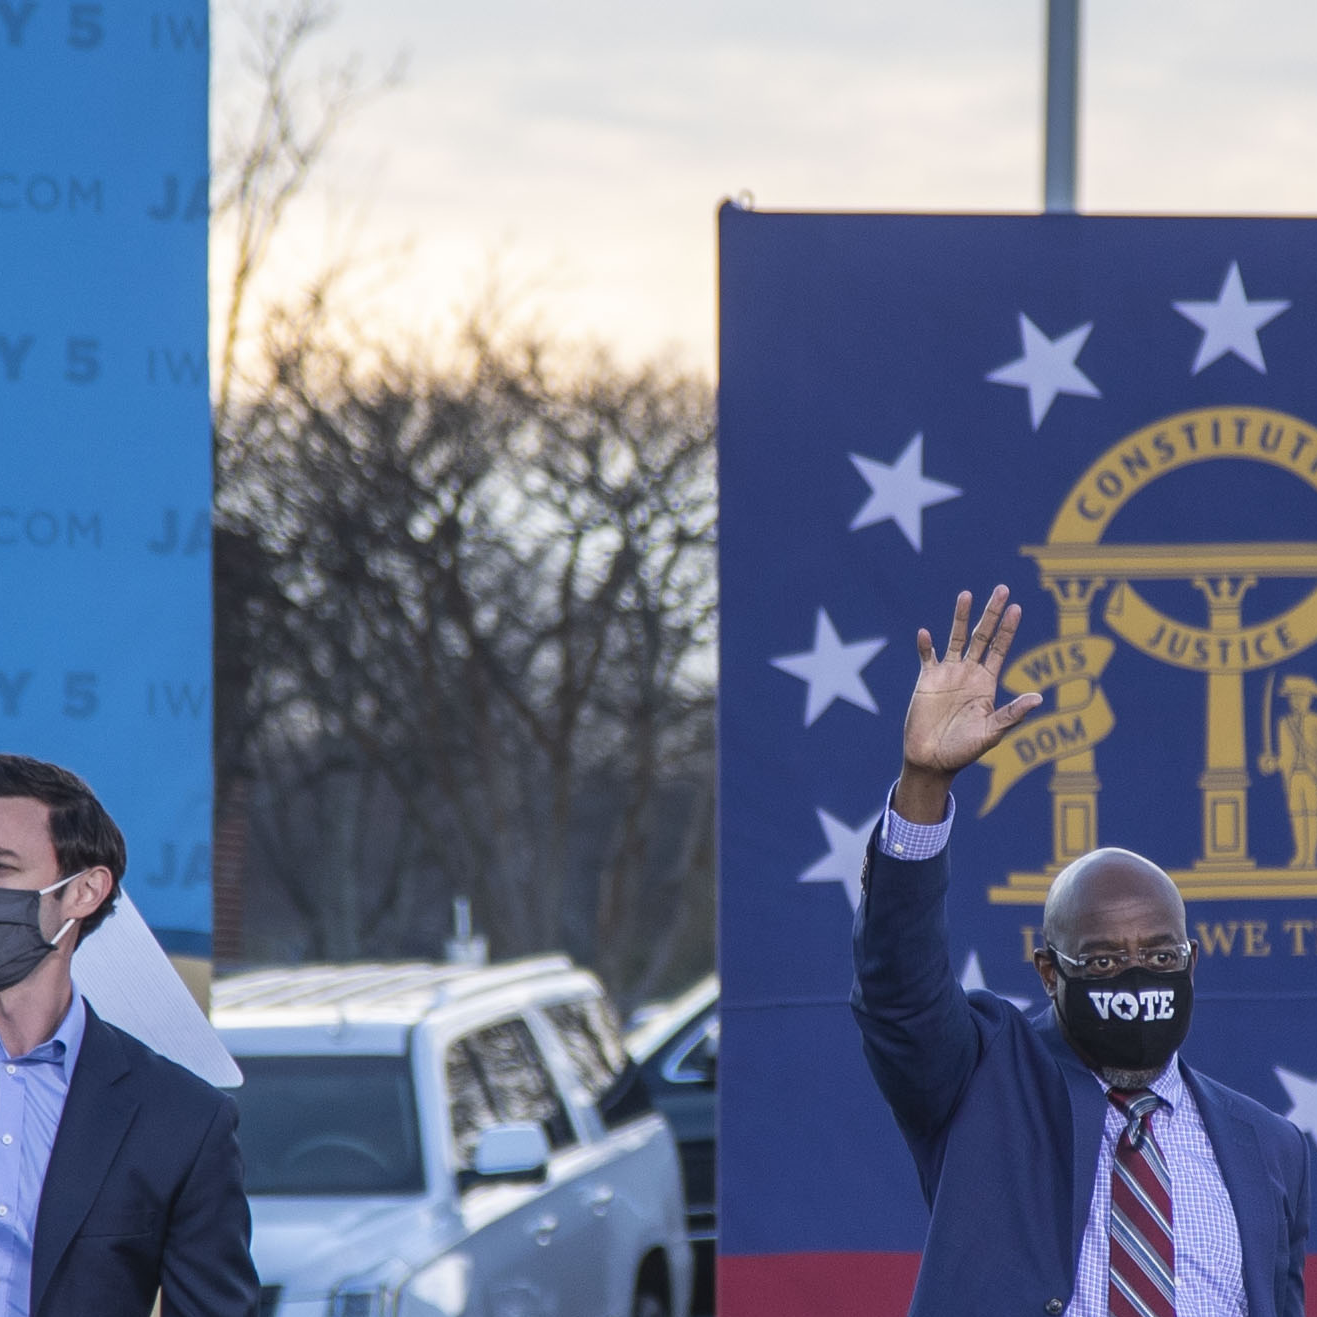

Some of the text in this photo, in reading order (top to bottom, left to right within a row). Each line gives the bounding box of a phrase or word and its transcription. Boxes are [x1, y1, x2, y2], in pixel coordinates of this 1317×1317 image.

[65, 5, 106, 51] 5
[61, 336, 104, 386] 5
[1025, 644, 1088, 688] WIS
[1149, 622, 1299, 668] JUSTICE
[60, 669, 101, 722] 5
[1014, 717, 1088, 762] DOM
[1196, 923, 1271, 957] WE
[1087, 989, 1175, 1021] VOTE
